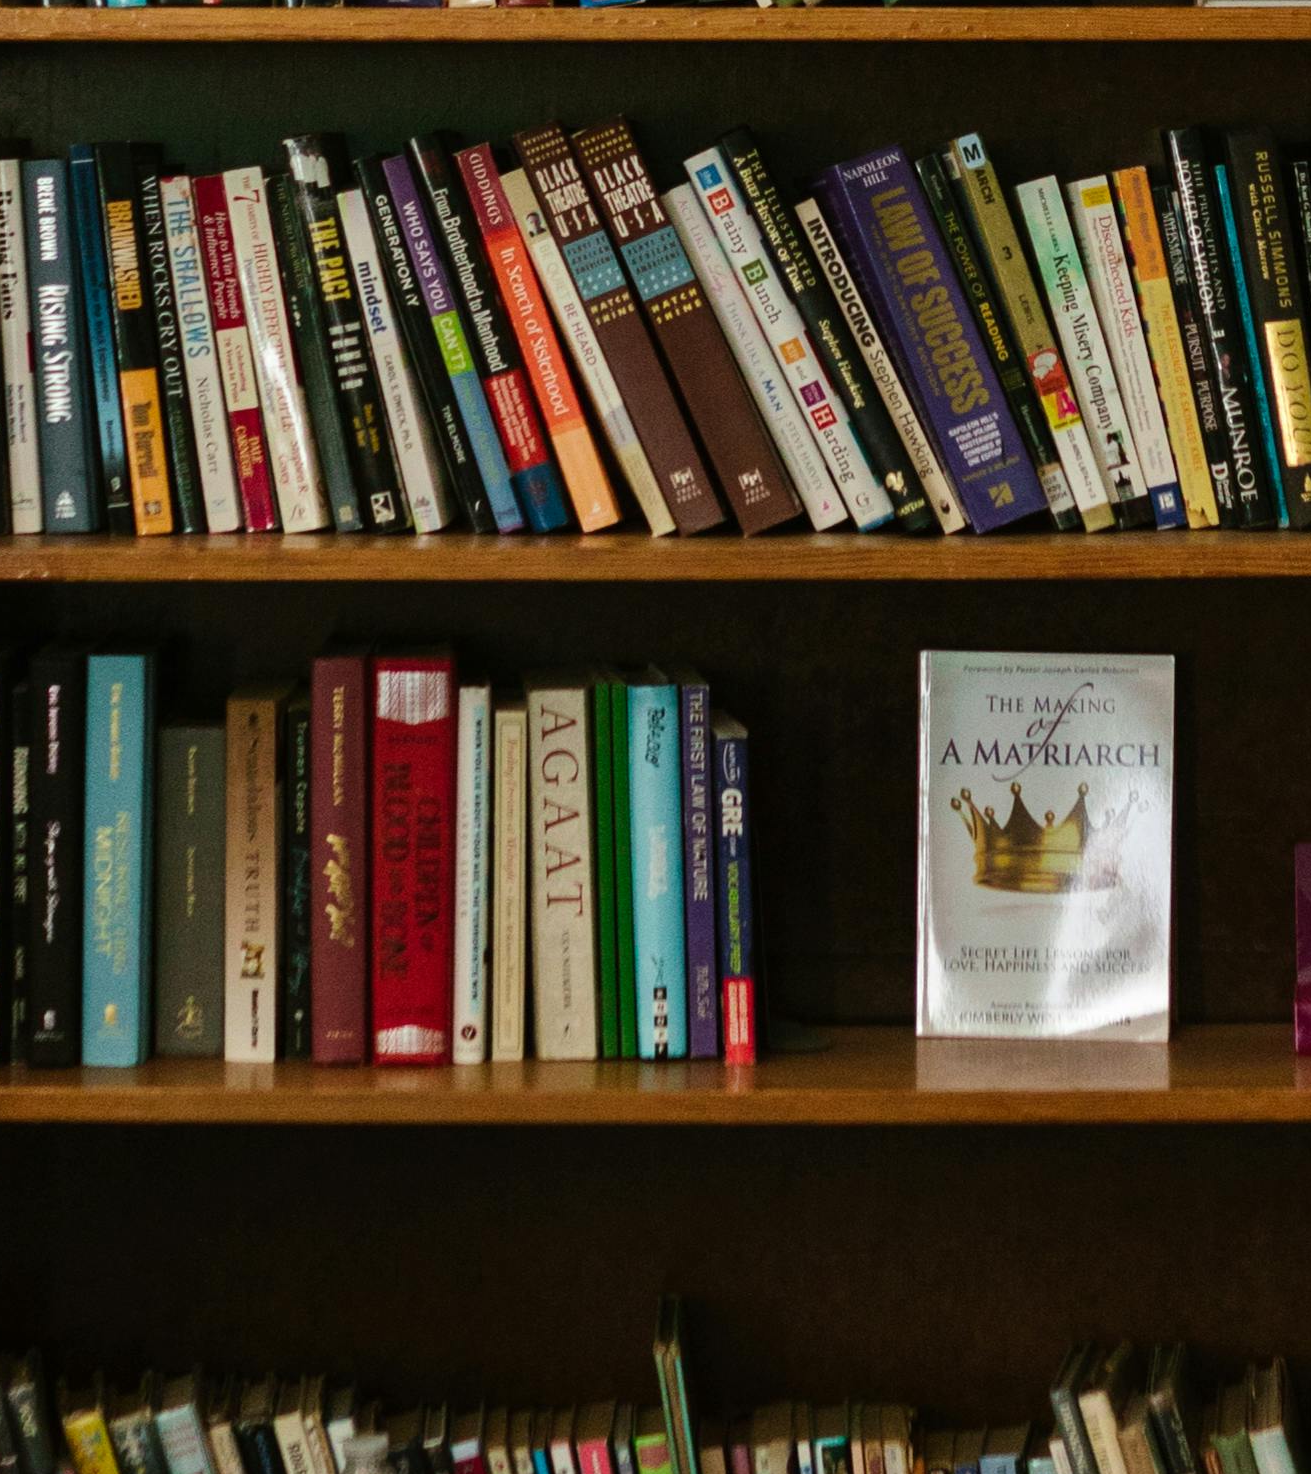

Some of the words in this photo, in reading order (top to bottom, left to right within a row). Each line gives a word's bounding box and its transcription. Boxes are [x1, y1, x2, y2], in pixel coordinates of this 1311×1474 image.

[593, 154, 644, 192] BLACK
[842, 152, 901, 184] NAPOLEON
[862, 171, 889, 189] HILL
[36, 176, 55, 216] BRENÉ
[141, 176, 161, 232] WHEN
[168, 198, 187, 238] THE
[602, 176, 655, 215] THEATRE
[871, 185, 928, 253] LAW
[40, 218, 58, 261] BROWN
[309, 217, 336, 252] THE
[375, 194, 412, 290] GENERATION
[1255, 150, 1278, 225] RUSSELL
[1268, 226, 1292, 308] SIMMONS
[148, 233, 171, 302] ROCKS
[317, 252, 351, 303] PACT
[499, 247, 516, 264] In
[895, 250, 939, 287] OF
[174, 244, 211, 359] SHALLOWS
[357, 261, 388, 335] mindset
[506, 264, 534, 320] Search
[806, 217, 876, 349] INTRODUCING
[38, 284, 71, 348] RISING
[157, 304, 178, 352] CRY
[524, 320, 542, 335] of
[979, 301, 1009, 362] READING
[530, 330, 570, 416] Sisterhood
[908, 284, 990, 415] SUCCESS
[43, 351, 73, 423] STRONG
[162, 358, 184, 398] OUT
[1220, 386, 1259, 503] MUNROE
[986, 694, 1024, 714] THE
[1033, 695, 1116, 715] MAKING
[940, 739, 963, 766] A
[973, 739, 1161, 767] MATRIARCH
[539, 703, 585, 918] AGAAT
[721, 787, 743, 838] GRE
